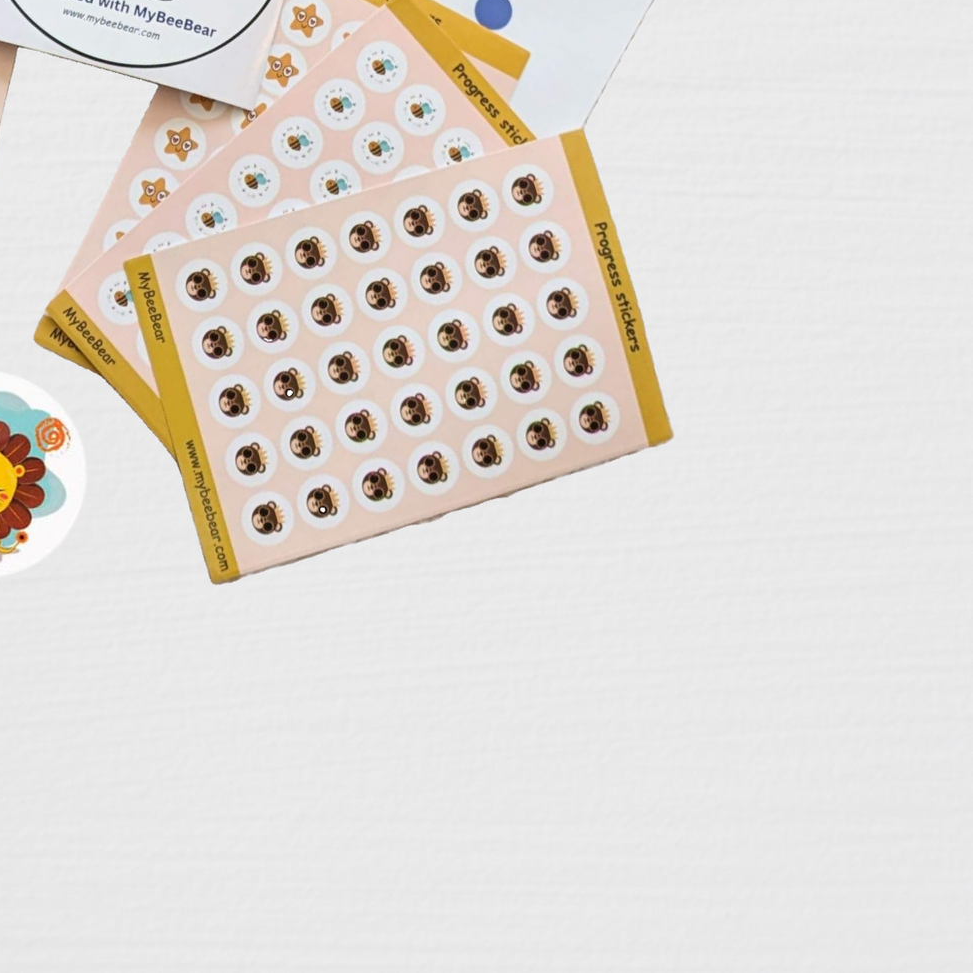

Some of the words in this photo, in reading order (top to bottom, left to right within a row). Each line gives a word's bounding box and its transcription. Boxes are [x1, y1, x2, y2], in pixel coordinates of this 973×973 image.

[62, 8, 161, 41] www.mybeebear.com
[133, 5, 217, 39] MyBeeBear
[452, 63, 500, 119] Progress
[138, 271, 166, 343] MyBeeBear
[594, 222, 622, 287] Progress
[615, 292, 640, 353] stickers
[62, 307, 116, 366] MyBeeBear
[185, 440, 229, 572] www.mybeebear.com
